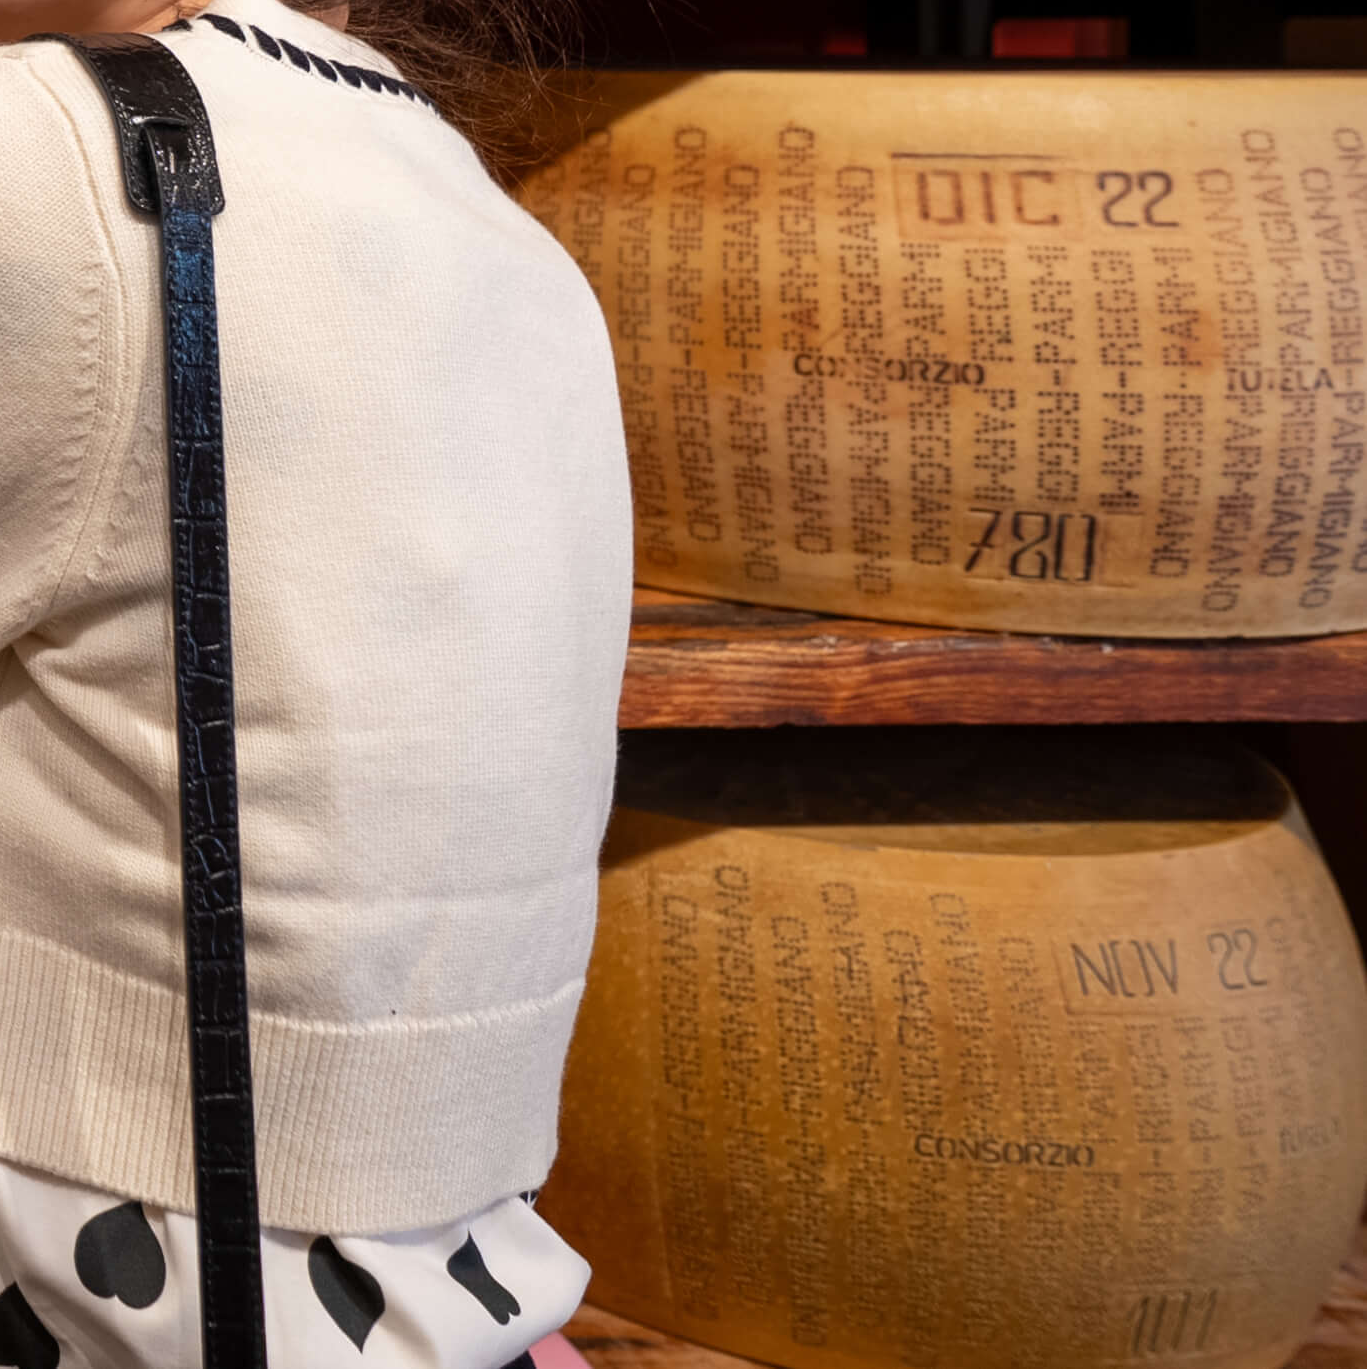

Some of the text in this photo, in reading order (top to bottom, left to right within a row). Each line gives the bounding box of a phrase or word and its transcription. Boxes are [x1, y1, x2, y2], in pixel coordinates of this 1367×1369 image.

[917, 169, 1180, 227] DIC 22
[792, 353, 1335, 393] CONSORZIO TUTELA
[963, 507, 1097, 582] 780
[1069, 929, 1267, 997] NOV 22
[913, 1132, 1095, 1168] CONSORZIO
